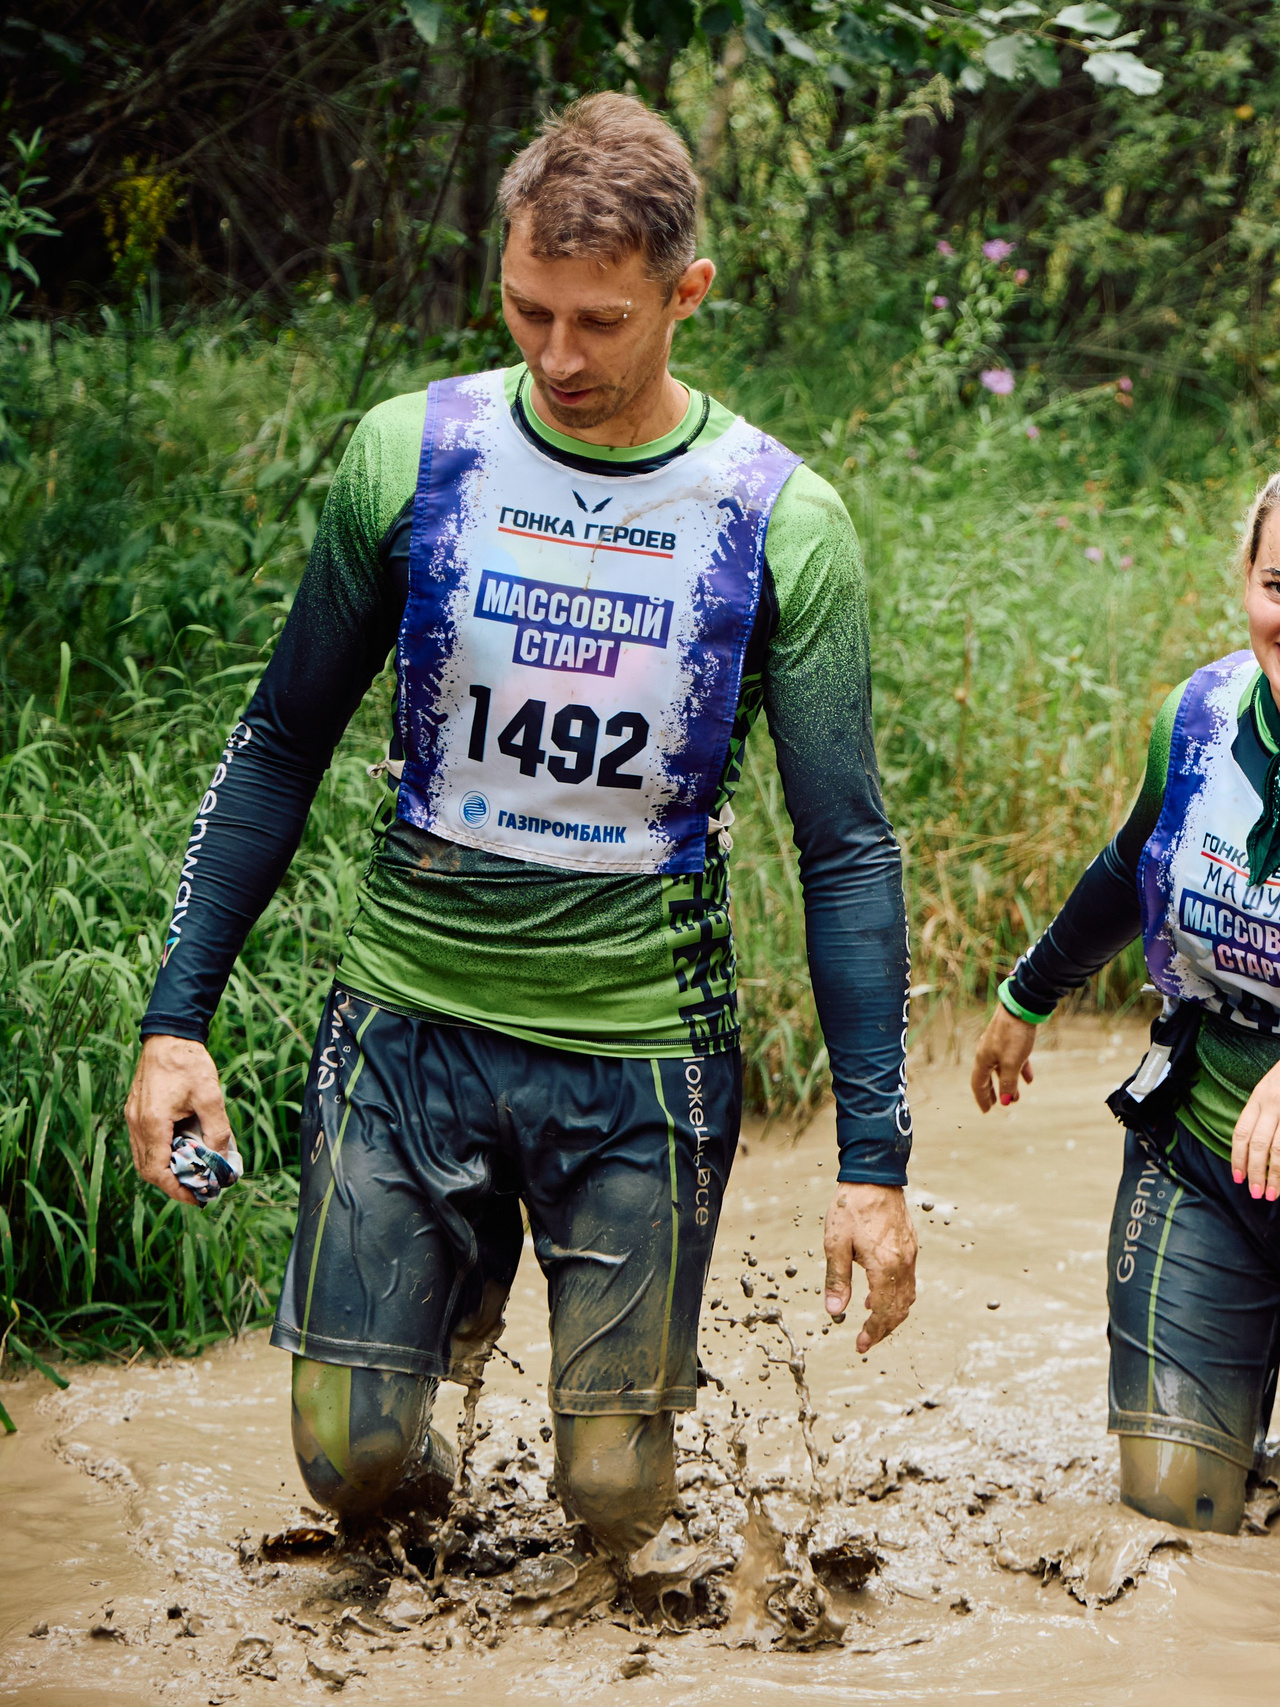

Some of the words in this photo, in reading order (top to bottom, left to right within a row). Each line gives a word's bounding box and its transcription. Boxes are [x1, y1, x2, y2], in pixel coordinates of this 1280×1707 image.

[499, 506, 576, 538] ГОНКА
[583, 512, 677, 552] ГЕРОЕВ
[482, 578, 664, 639] МАССОВЫЙ
[518, 631, 615, 673] СТАРТ
[467, 684, 651, 790] 1492
[497, 810, 627, 845] ГАЗПРОМБАНК
